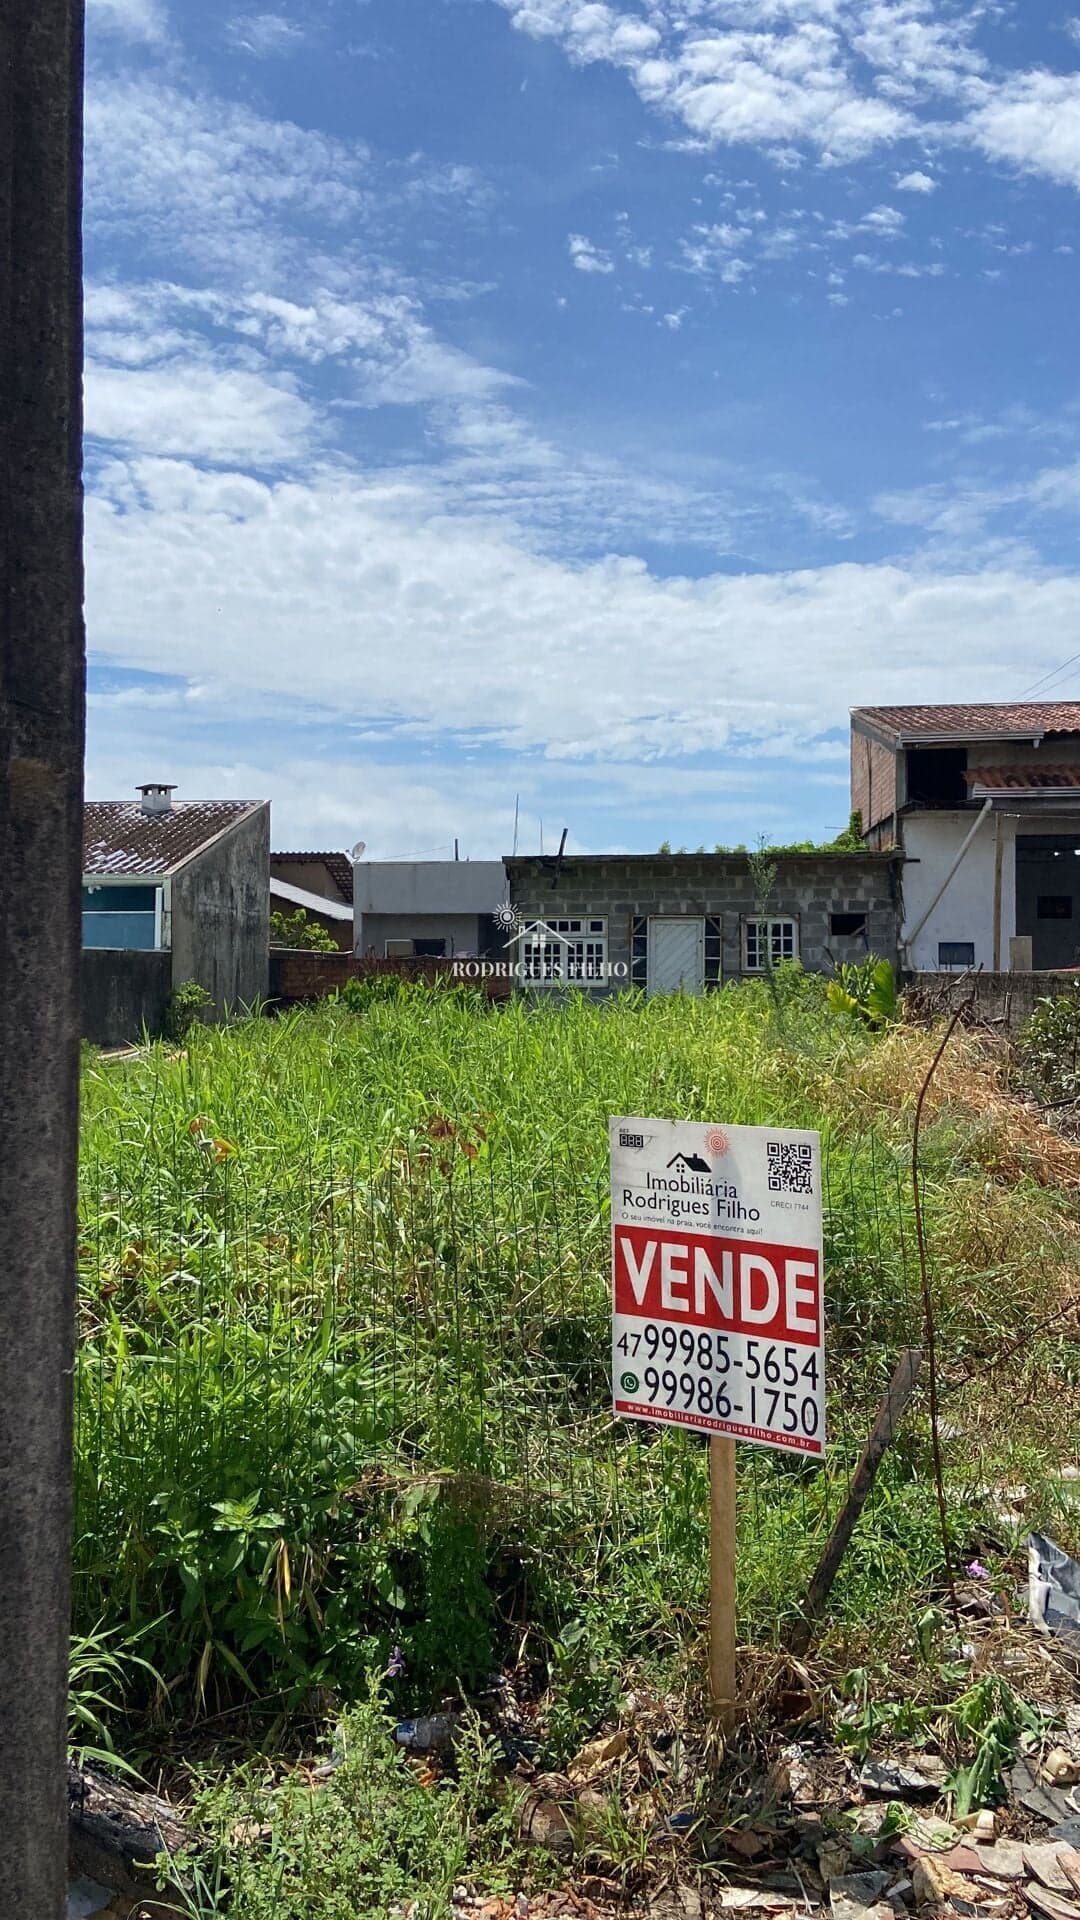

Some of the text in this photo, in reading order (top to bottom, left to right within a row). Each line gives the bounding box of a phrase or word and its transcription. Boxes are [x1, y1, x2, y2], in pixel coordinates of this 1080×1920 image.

[646, 1171, 737, 1198] Imobiliária
[623, 1190, 760, 1221] Rodrigues Filho
[770, 1200, 792, 1209] CRECI
[621, 1211, 629, 1219] O
[713, 1223, 744, 1233] encontra
[619, 1237, 817, 1334] VENDE
[644, 1367, 818, 1436] 99986-1750
